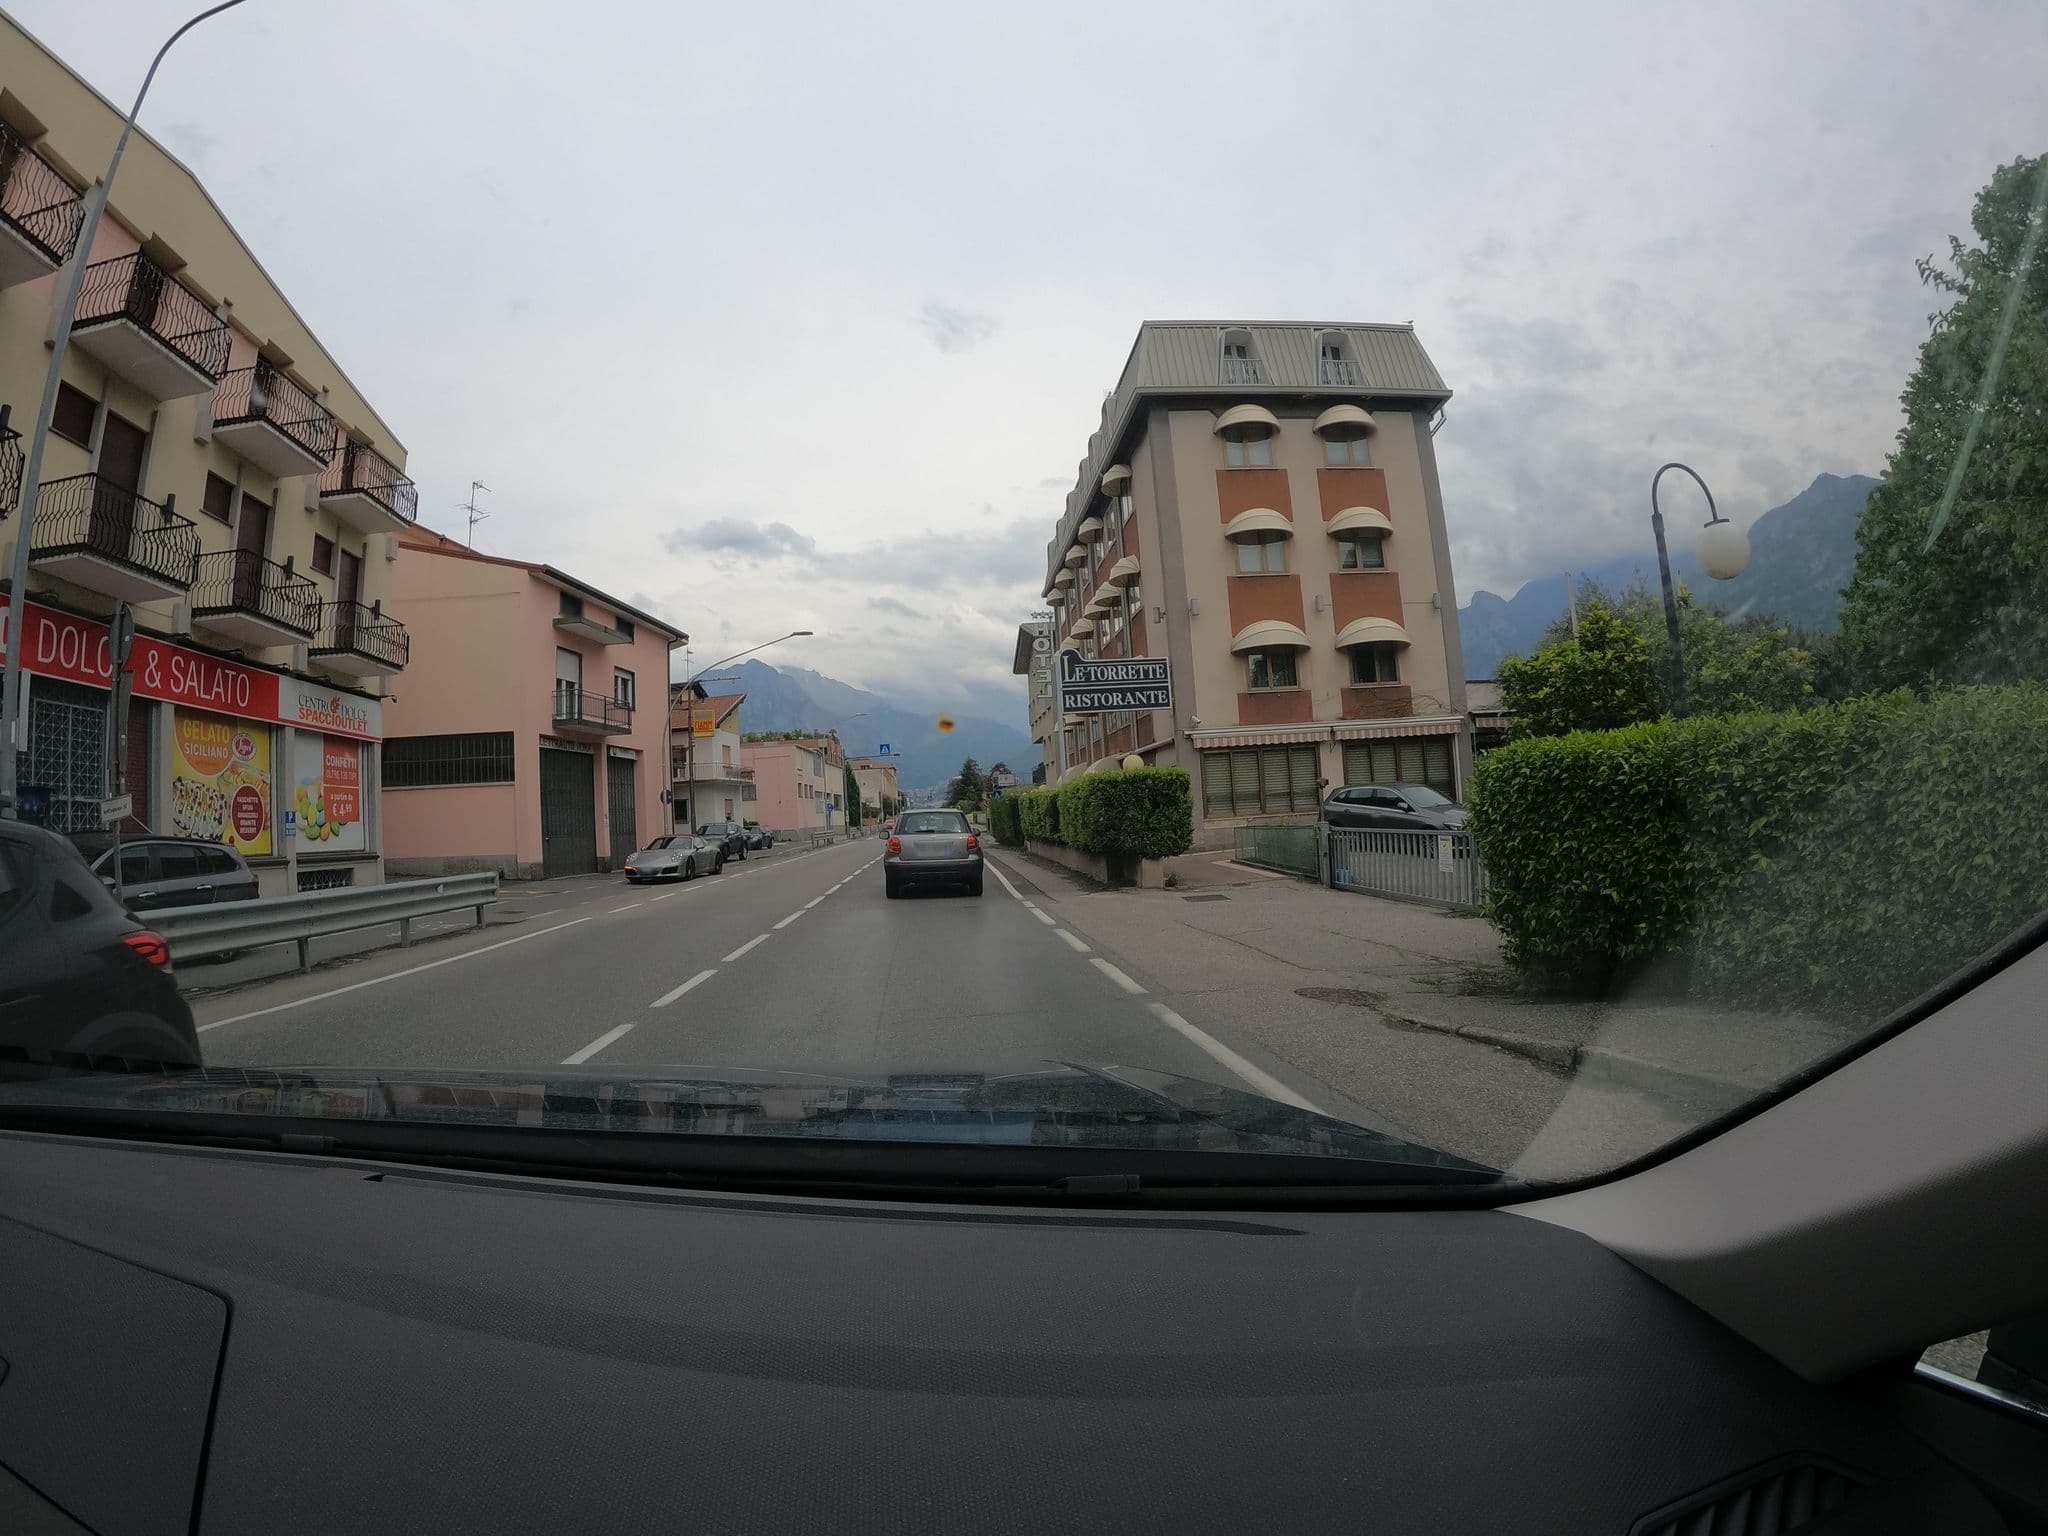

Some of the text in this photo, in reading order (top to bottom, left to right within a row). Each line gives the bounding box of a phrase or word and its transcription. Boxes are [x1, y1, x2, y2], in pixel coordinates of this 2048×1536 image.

[37, 618, 113, 678] DOLC
[144, 649, 161, 689] &
[170, 655, 250, 708] SALATO
[1086, 664, 1166, 680] TORRETTE
[1064, 690, 1168, 708] RISTORANTE
[298, 707, 368, 733] SPACCIOUTLET
[341, 704, 368, 722] DOLCE
[183, 719, 230, 744] GELATO
[184, 742, 229, 760] SICILIANO
[325, 754, 357, 769] CONFETTI
